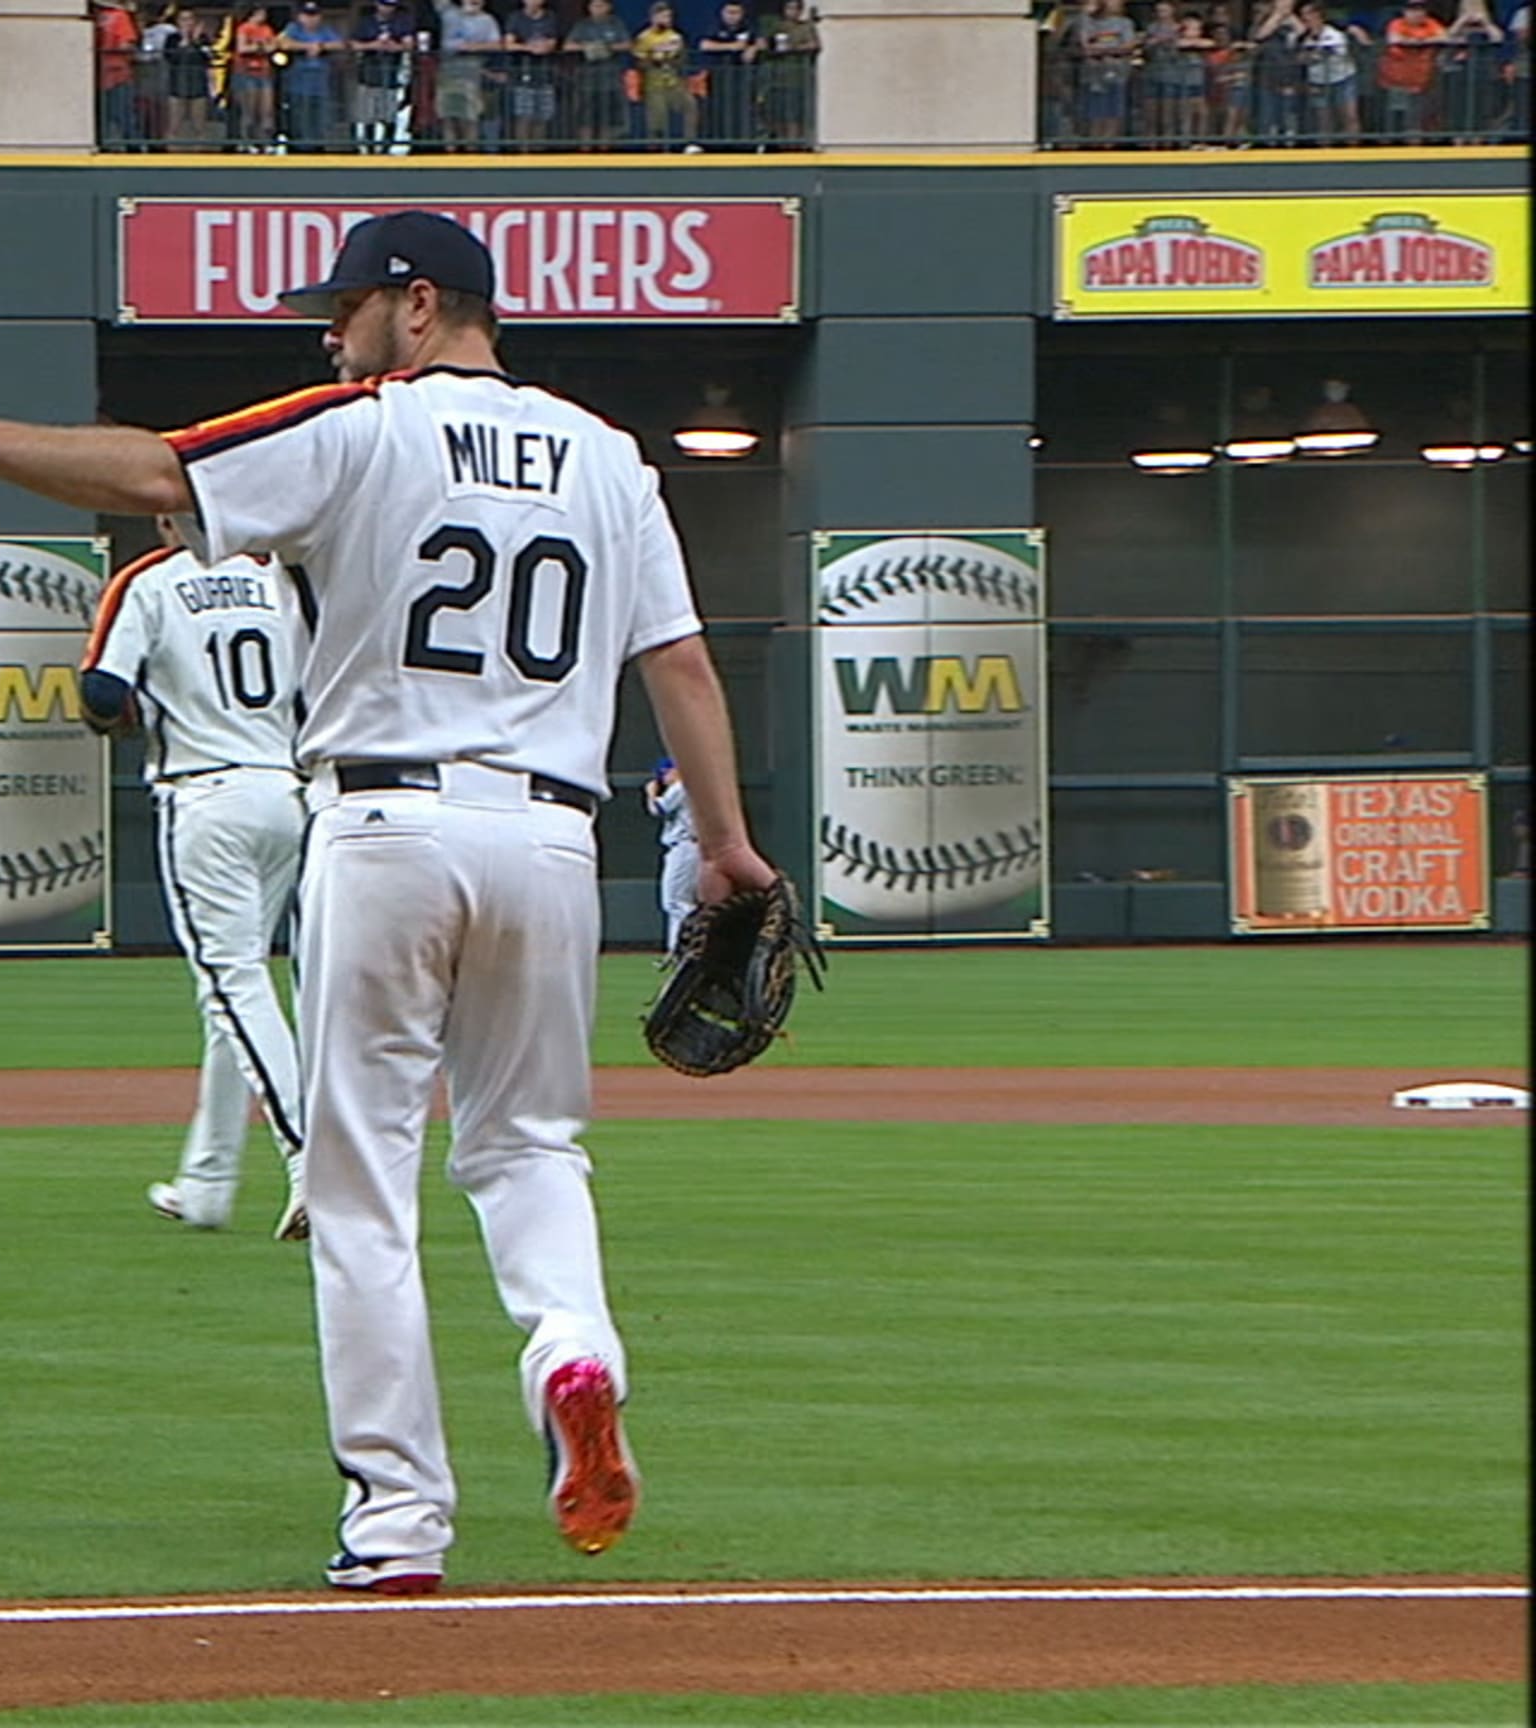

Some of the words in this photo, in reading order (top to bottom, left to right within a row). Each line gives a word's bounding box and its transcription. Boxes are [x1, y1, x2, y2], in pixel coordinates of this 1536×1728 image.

[195, 209, 712, 312] FUDCKERS
[1086, 241, 1158, 284] PAPA
[1313, 238, 1383, 281] PAPA
[443, 423, 570, 494] MILEY
[175, 576, 275, 613] GURRIEL
[402, 524, 588, 683] 20
[205, 627, 276, 710] 10
[835, 657, 1022, 714] WM
[844, 766, 923, 788] THINK
[1334, 784, 1454, 818] TEXAS
[1335, 821, 1462, 846] ORIGINAL
[1338, 849, 1464, 884] CRAFT
[1337, 885, 1464, 918] VODKA
